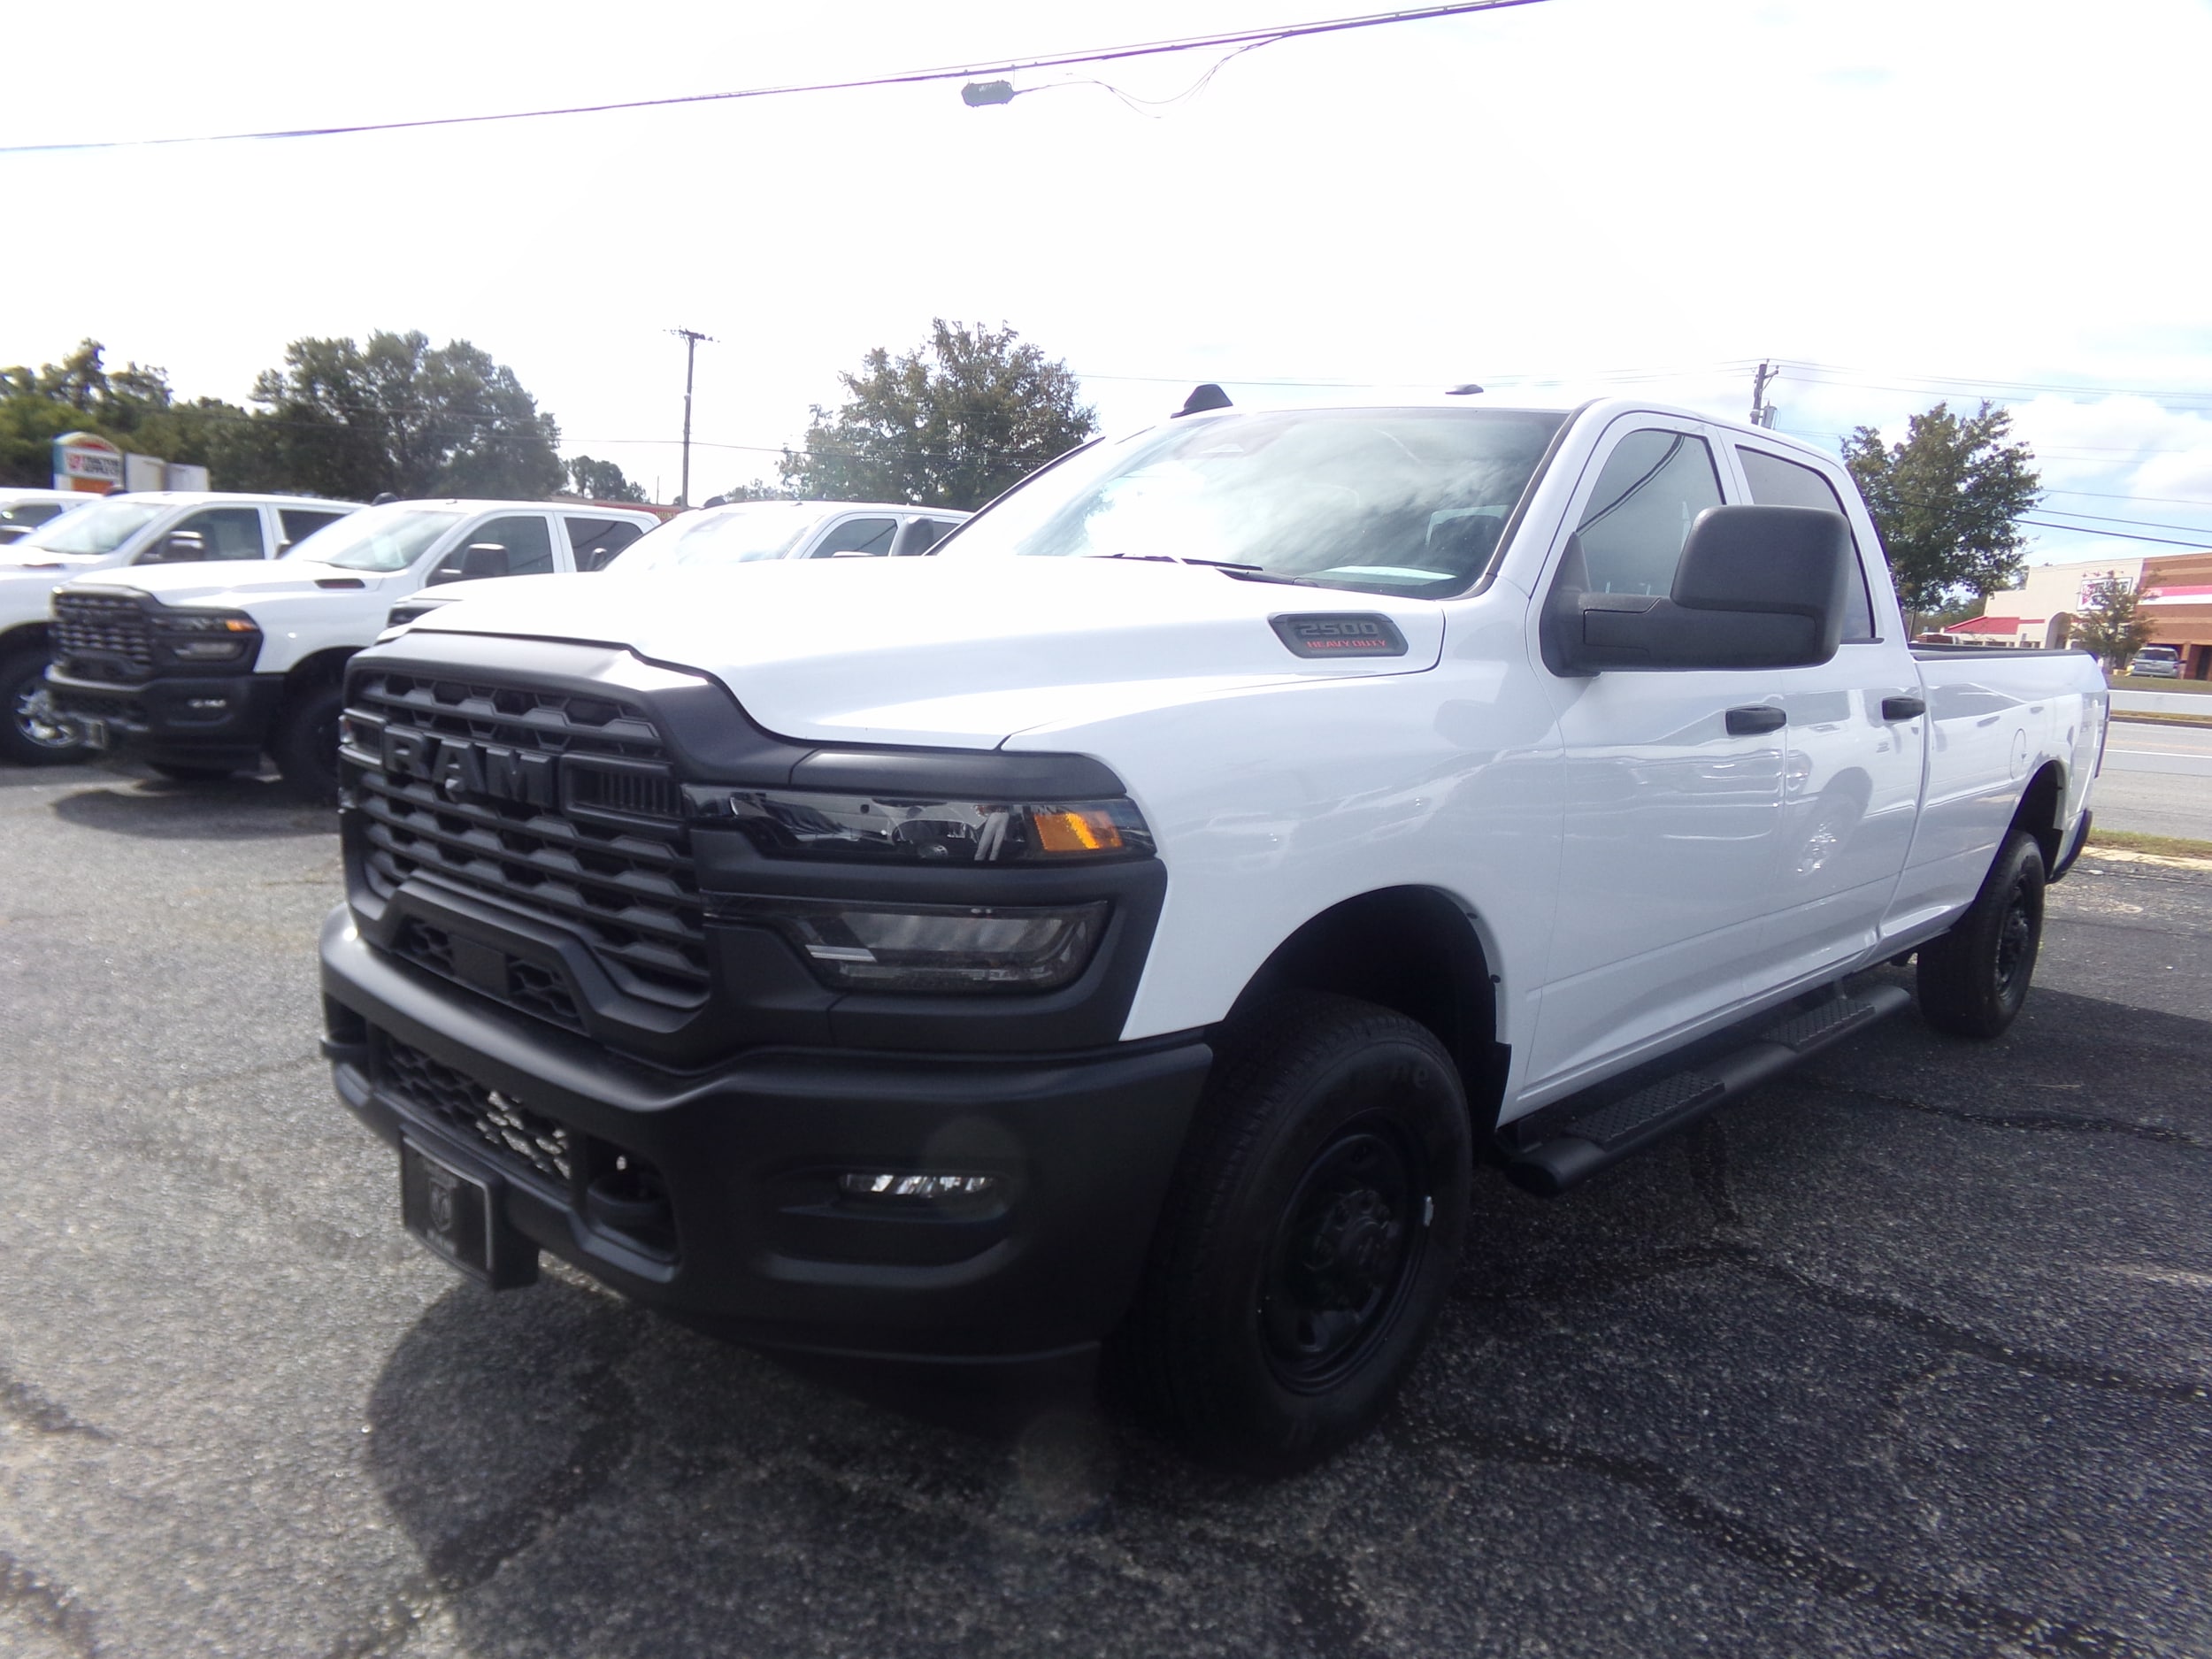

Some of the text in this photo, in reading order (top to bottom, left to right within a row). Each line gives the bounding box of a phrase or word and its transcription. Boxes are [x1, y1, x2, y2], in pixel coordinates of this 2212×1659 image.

[1299, 623, 1379, 635] 2500
[1352, 639, 1386, 648] DUTY
[383, 725, 553, 808] RAM
